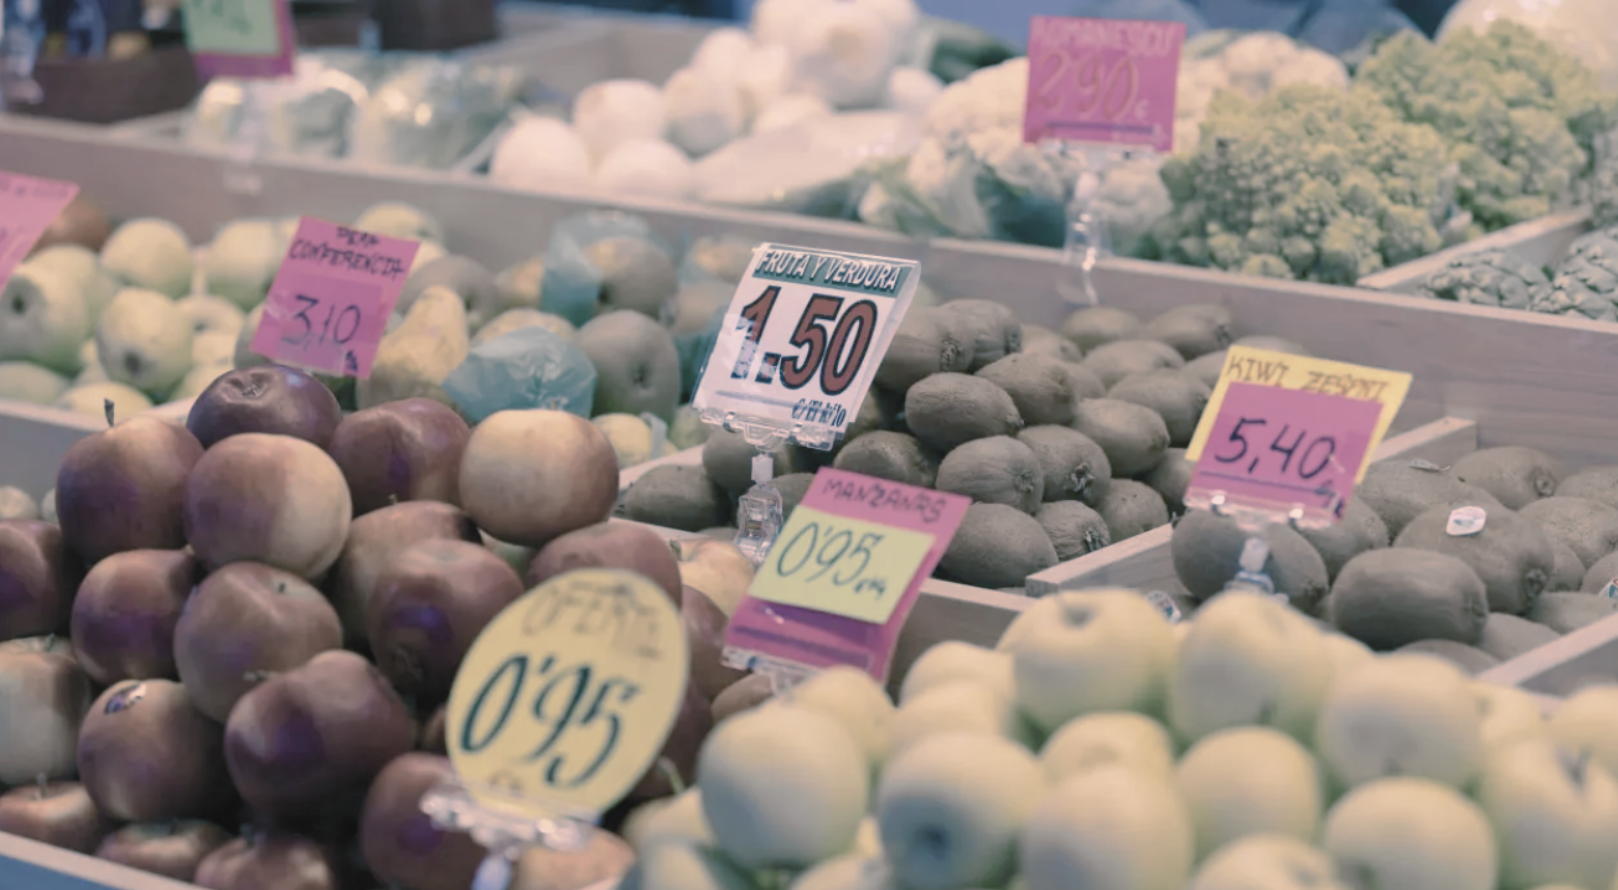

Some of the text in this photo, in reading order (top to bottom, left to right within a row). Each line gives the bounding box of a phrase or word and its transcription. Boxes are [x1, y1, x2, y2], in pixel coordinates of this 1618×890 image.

[288, 238, 404, 282] CONFERENCIA
[754, 250, 901, 294] FRUTA Y VERDURA
[729, 284, 878, 396] 1.50
[1226, 355, 1290, 387] KIWI
[1213, 417, 1336, 480] 5,40
[776, 522, 886, 587] 0'95
[459, 653, 643, 789] 0'95
